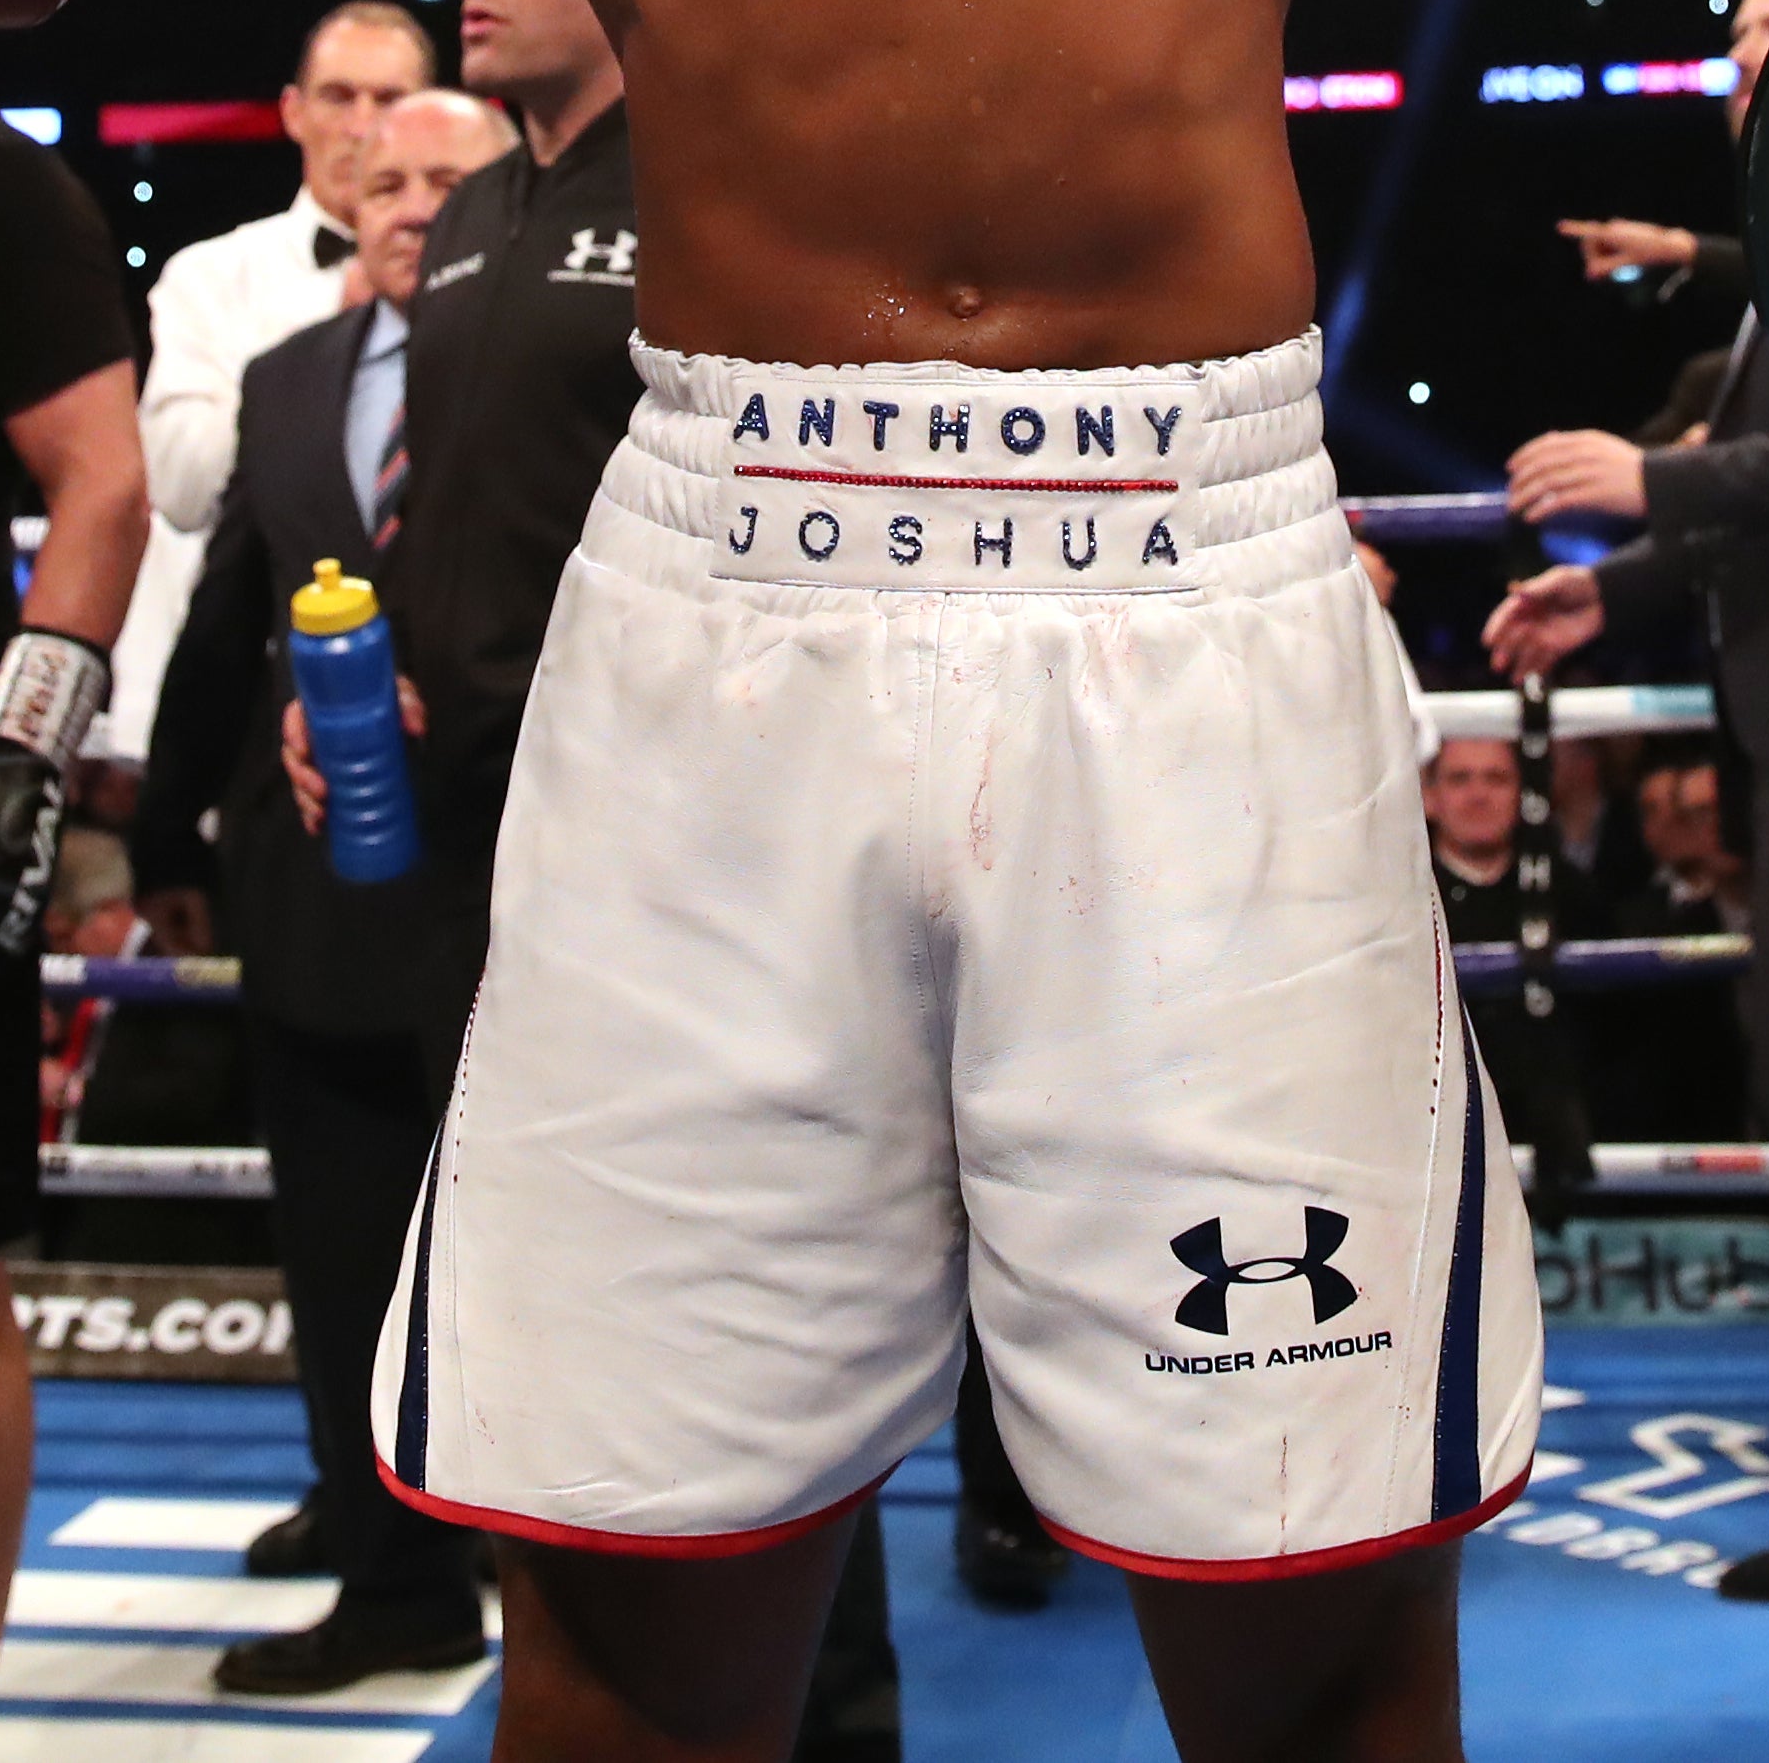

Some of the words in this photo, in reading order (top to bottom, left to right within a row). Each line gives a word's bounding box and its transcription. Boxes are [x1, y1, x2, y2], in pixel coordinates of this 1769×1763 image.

[732, 393, 1183, 456] ANTHONY
[728, 505, 1179, 570] JOSHUA
[1144, 1351, 1256, 1375] UNDER
[1265, 1330, 1393, 1368] ARMOUR
